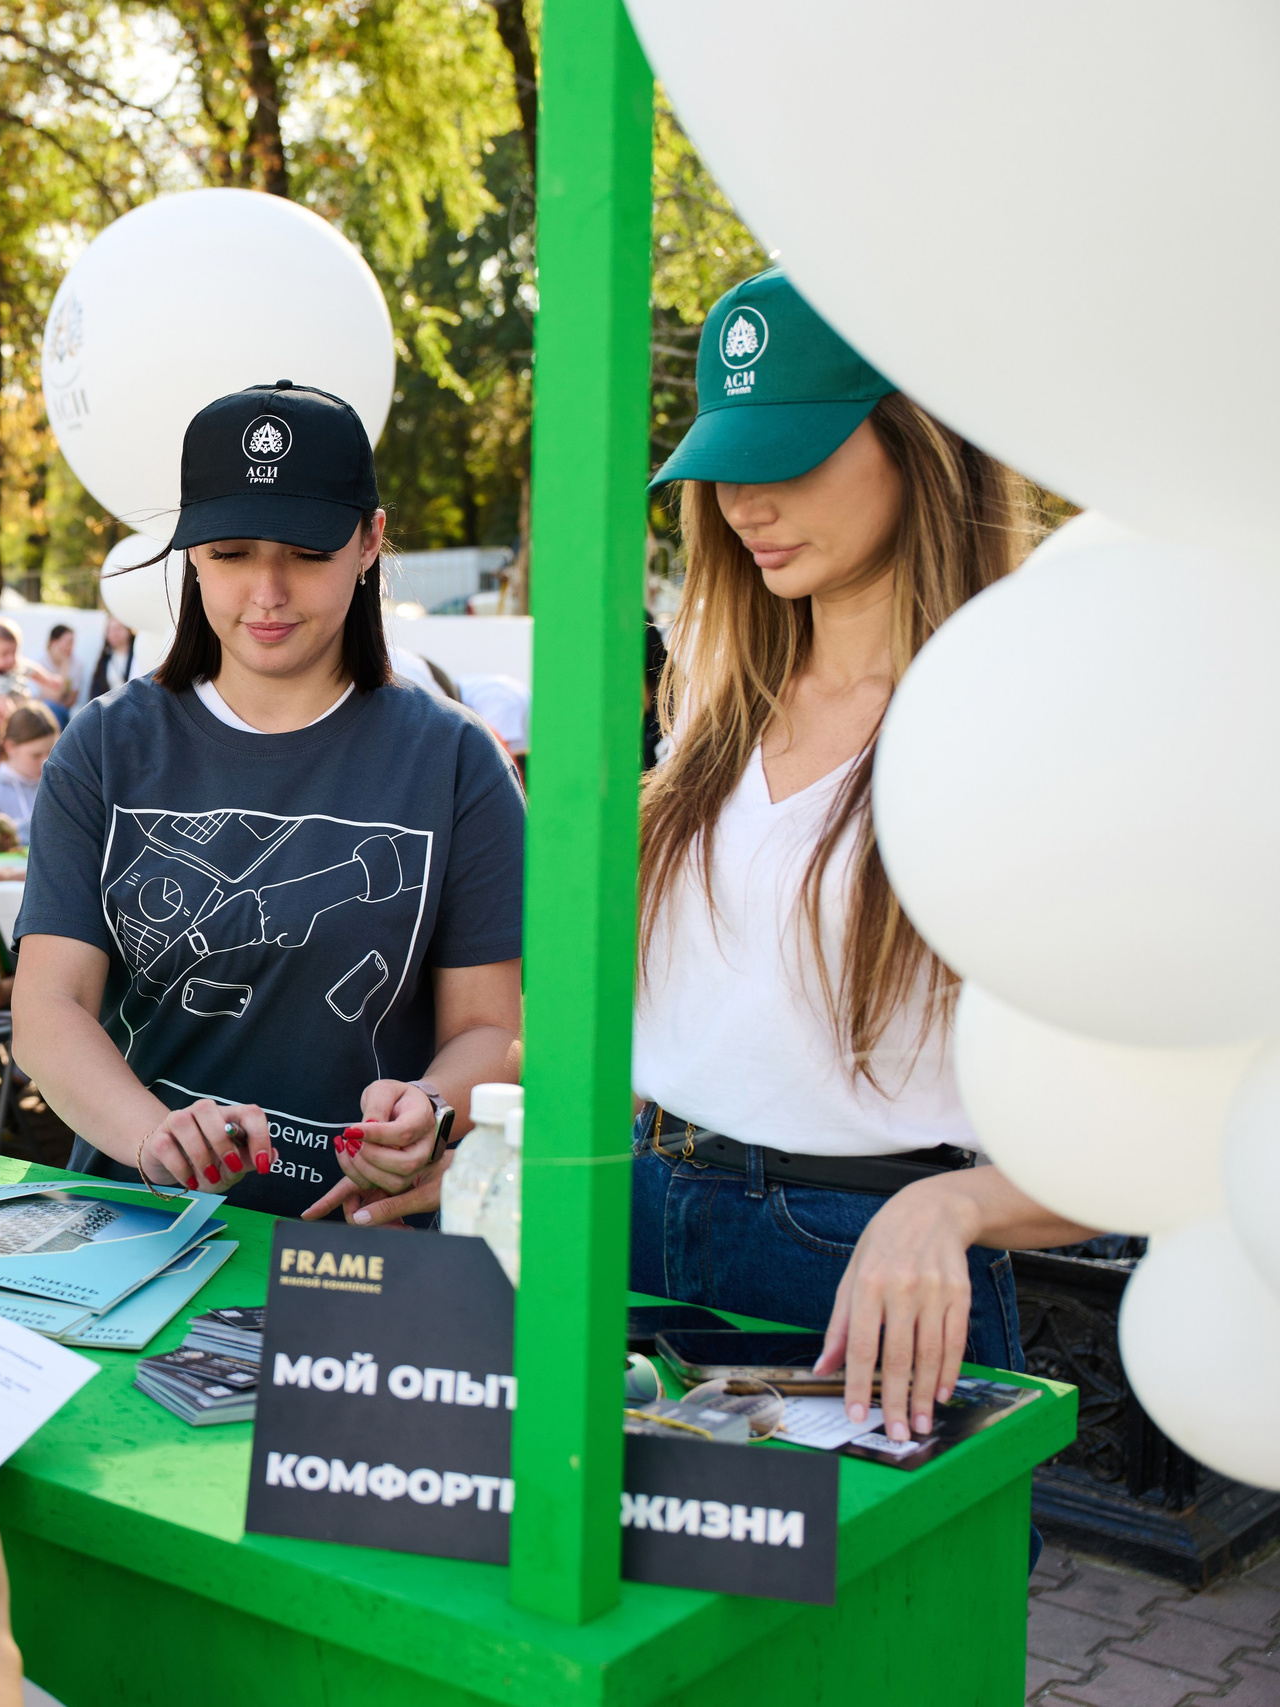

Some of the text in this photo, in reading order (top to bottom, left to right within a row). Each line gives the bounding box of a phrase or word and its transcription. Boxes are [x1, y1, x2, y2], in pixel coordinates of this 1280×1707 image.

[723, 370, 755, 389] АСИ
[245, 465, 278, 478] АСИ
[280, 1248, 384, 1280] FRAME
[273, 1351, 379, 1396] МОЙ
[619, 1492, 805, 1549] ЖИЗНИ
